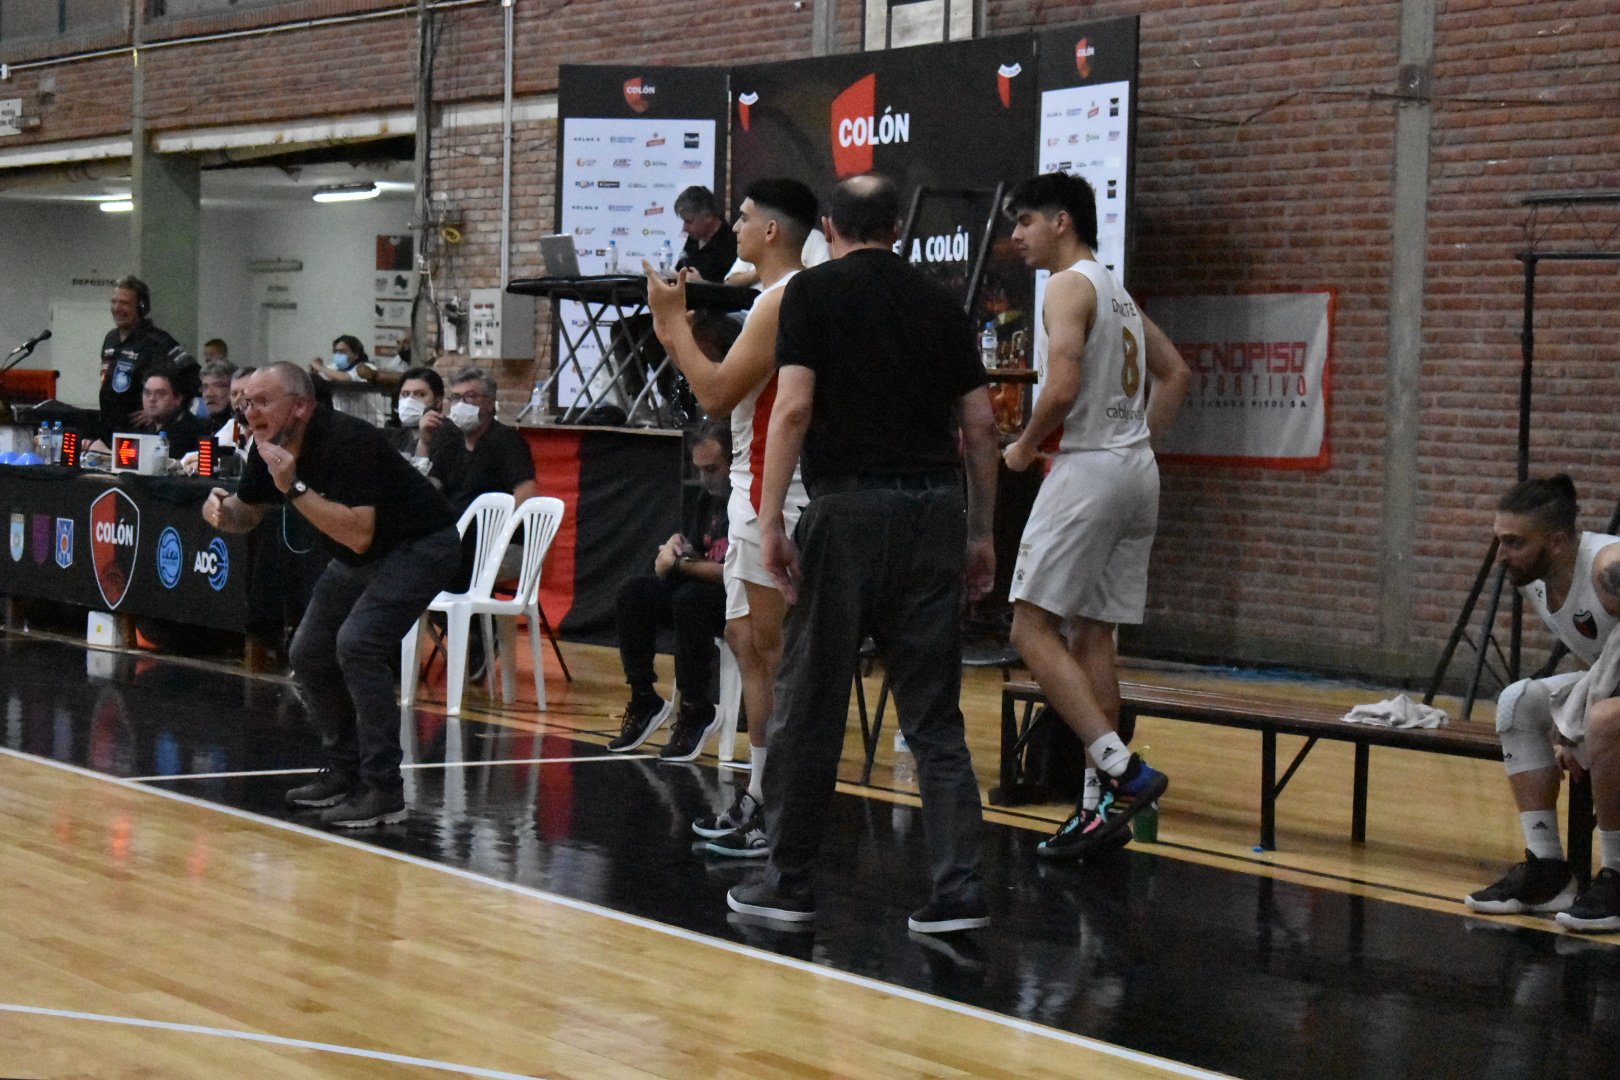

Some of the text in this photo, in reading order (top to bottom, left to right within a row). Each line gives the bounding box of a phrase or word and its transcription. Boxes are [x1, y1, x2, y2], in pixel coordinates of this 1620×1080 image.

[626, 85, 656, 95] COLÓN
[838, 105, 910, 148] COLÓN
[1122, 326, 1140, 398] 8
[96, 518, 134, 547] COLÓN
[193, 549, 218, 575] ADC
